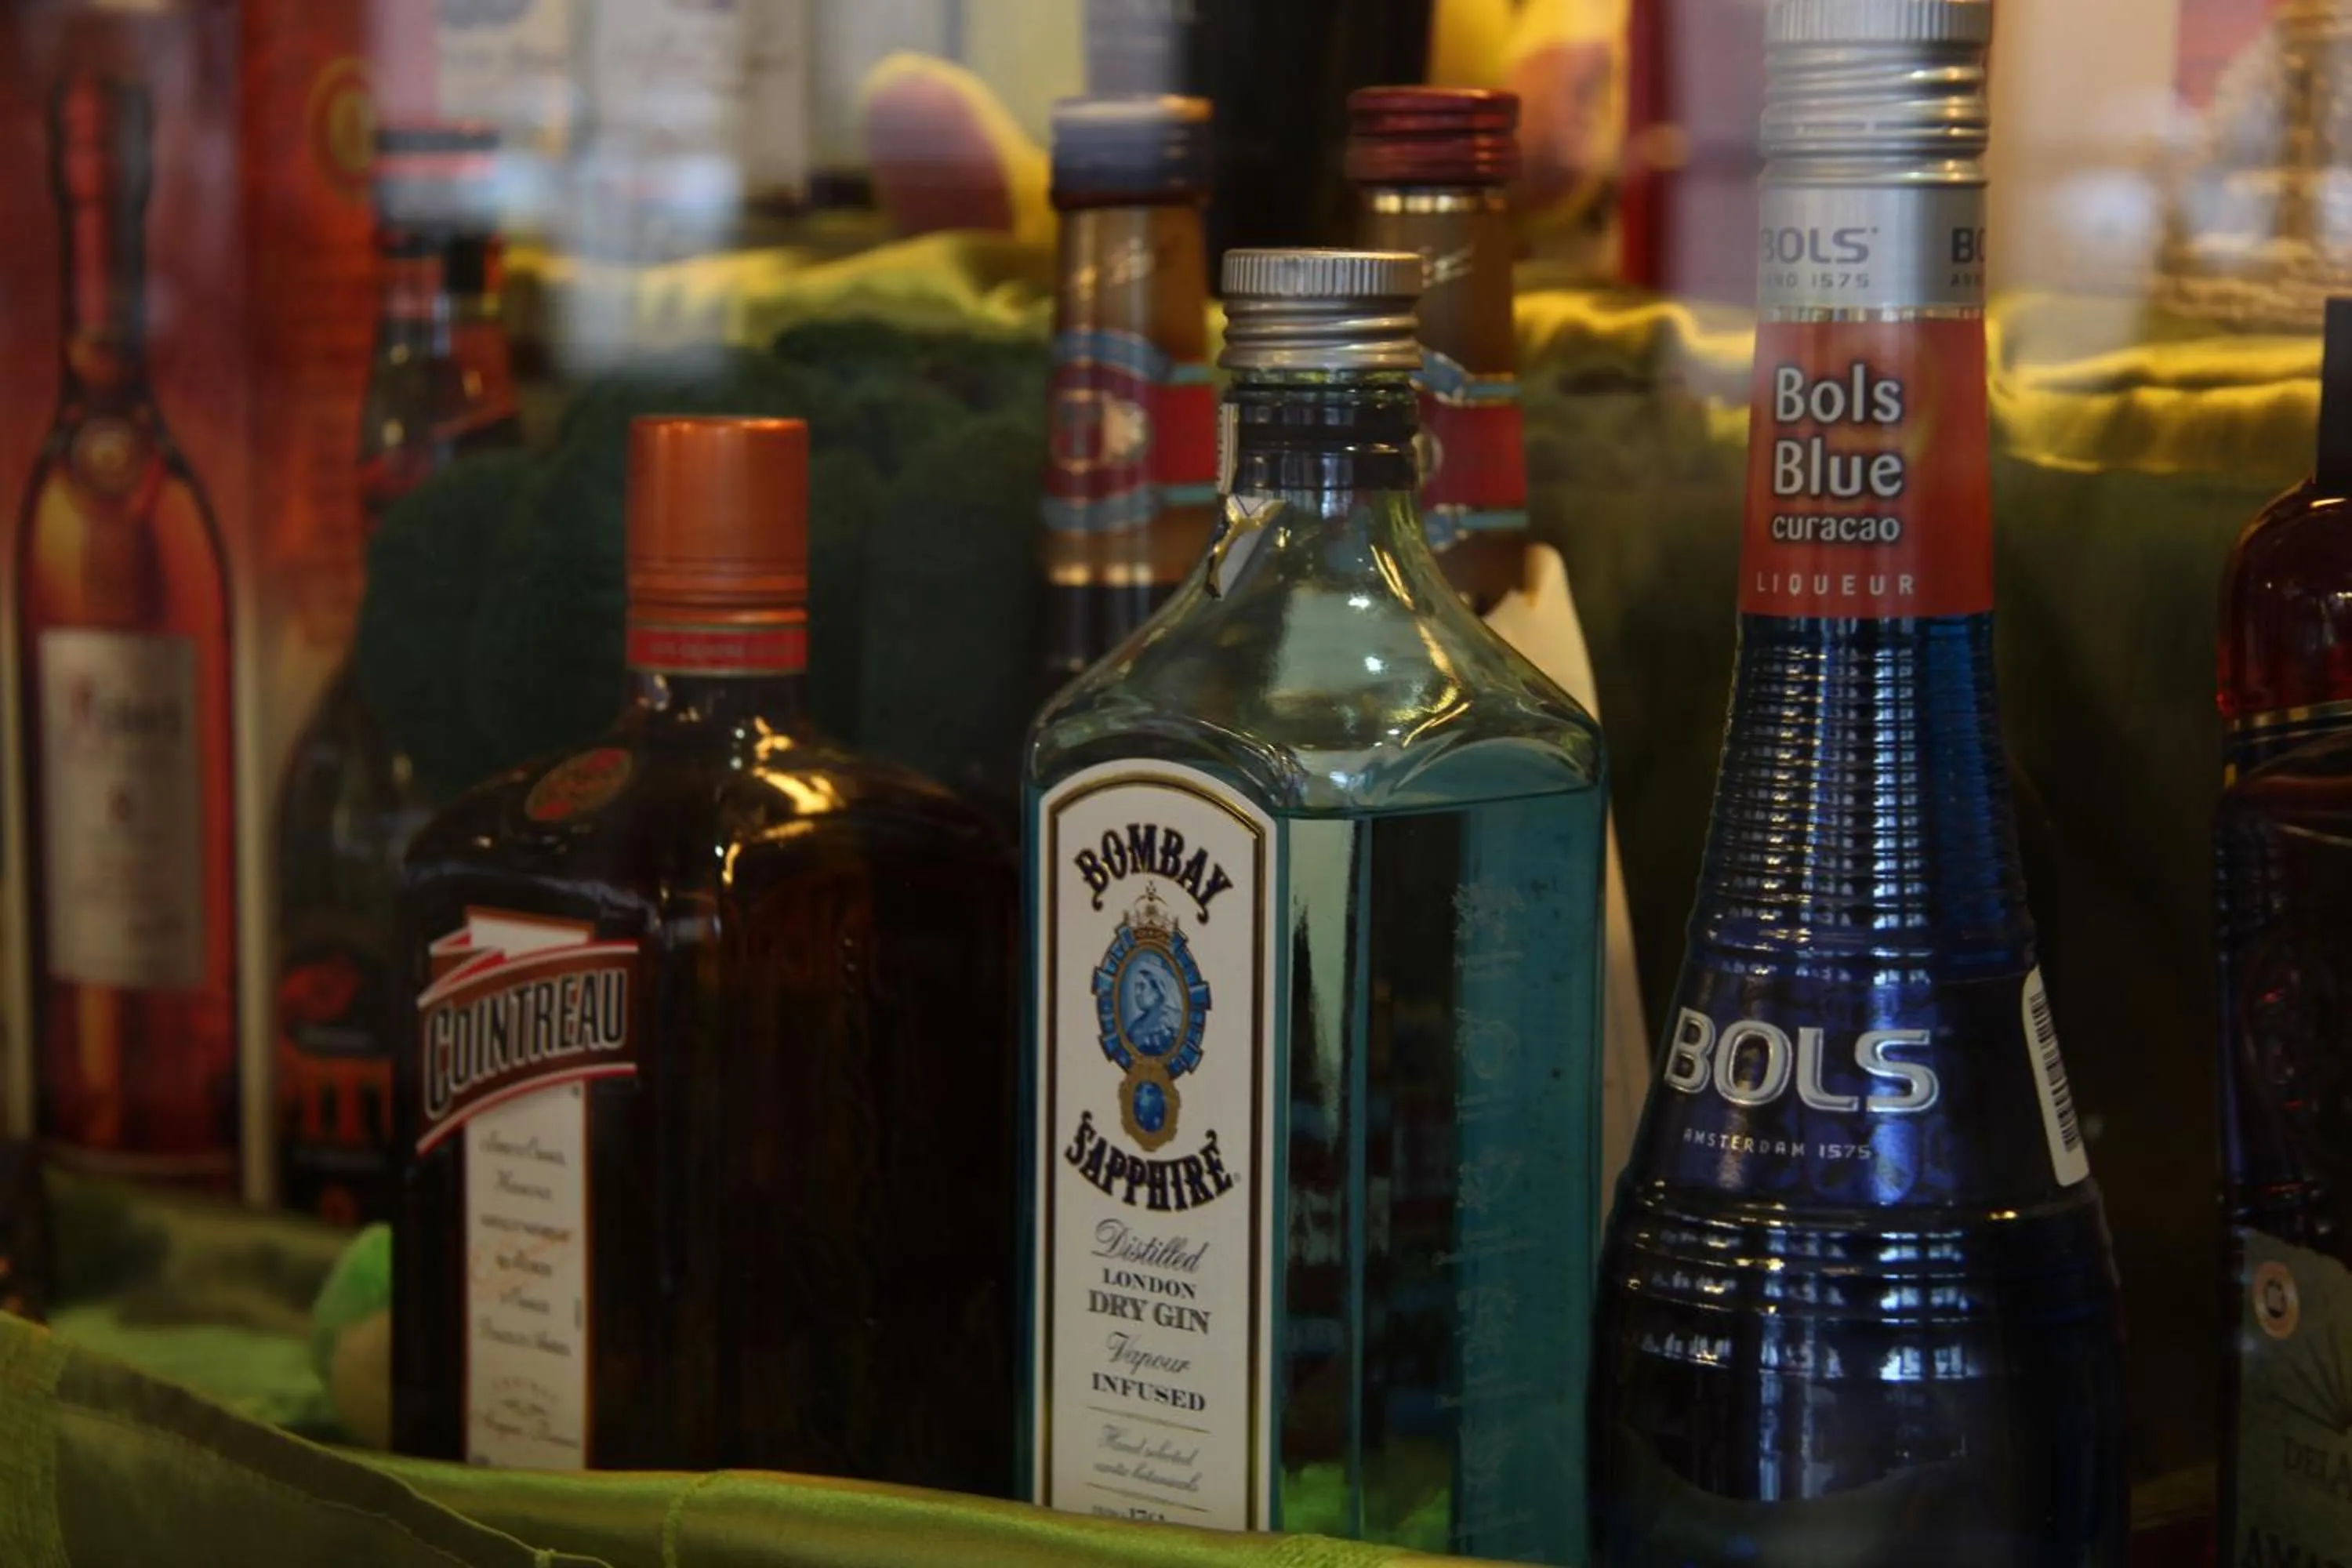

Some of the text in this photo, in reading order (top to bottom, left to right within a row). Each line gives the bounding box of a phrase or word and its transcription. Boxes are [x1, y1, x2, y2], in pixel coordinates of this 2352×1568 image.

[1760, 227, 1870, 264] BOLS
[1811, 273, 1870, 289] 1575
[1775, 362, 1903, 423] Bols
[1773, 437, 1904, 497] Blue
[1771, 516, 1901, 542] curacao
[1756, 572, 1915, 596] LIQUEUR
[1073, 822, 1234, 925] BOMBAY
[424, 968, 627, 1121] COINTREAU
[1663, 1006, 1941, 1114] BOLS
[1063, 1109, 1234, 1212] SAPPHIRE
[1684, 1127, 1873, 1160] AMSTERDAM 1575
[1090, 1218, 1210, 1275] Distilled
[1102, 1267, 1197, 1300] LONDON
[1086, 1288, 1212, 1335] DRY GIN
[1105, 1330, 1192, 1375] Vapour
[1091, 1371, 1206, 1412] INFUSED
